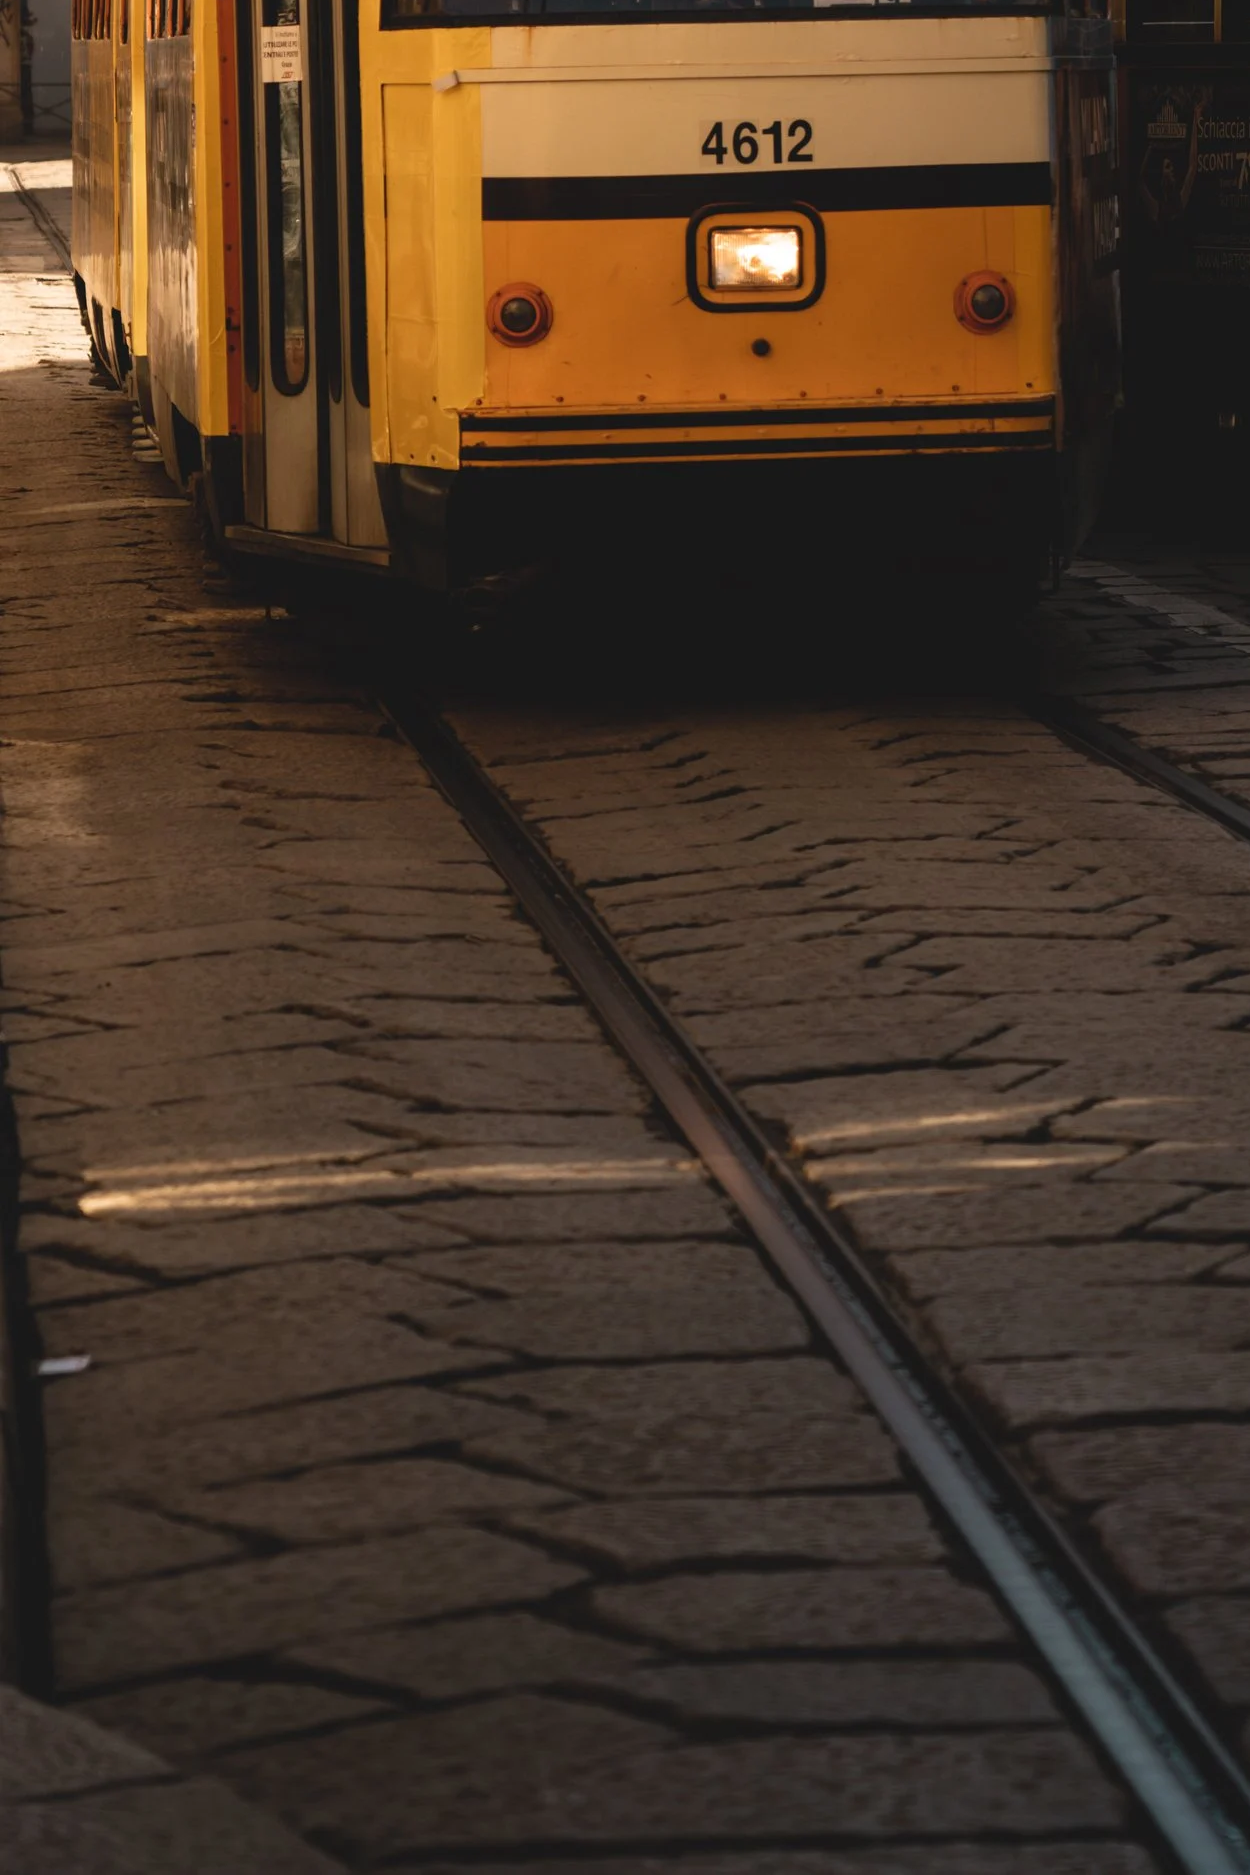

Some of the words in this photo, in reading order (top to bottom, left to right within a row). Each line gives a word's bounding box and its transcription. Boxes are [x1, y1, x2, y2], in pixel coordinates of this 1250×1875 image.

[1197, 116, 1245, 140] Schiaccia
[701, 119, 813, 165] 4612
[1197, 151, 1234, 173] SCONTI
